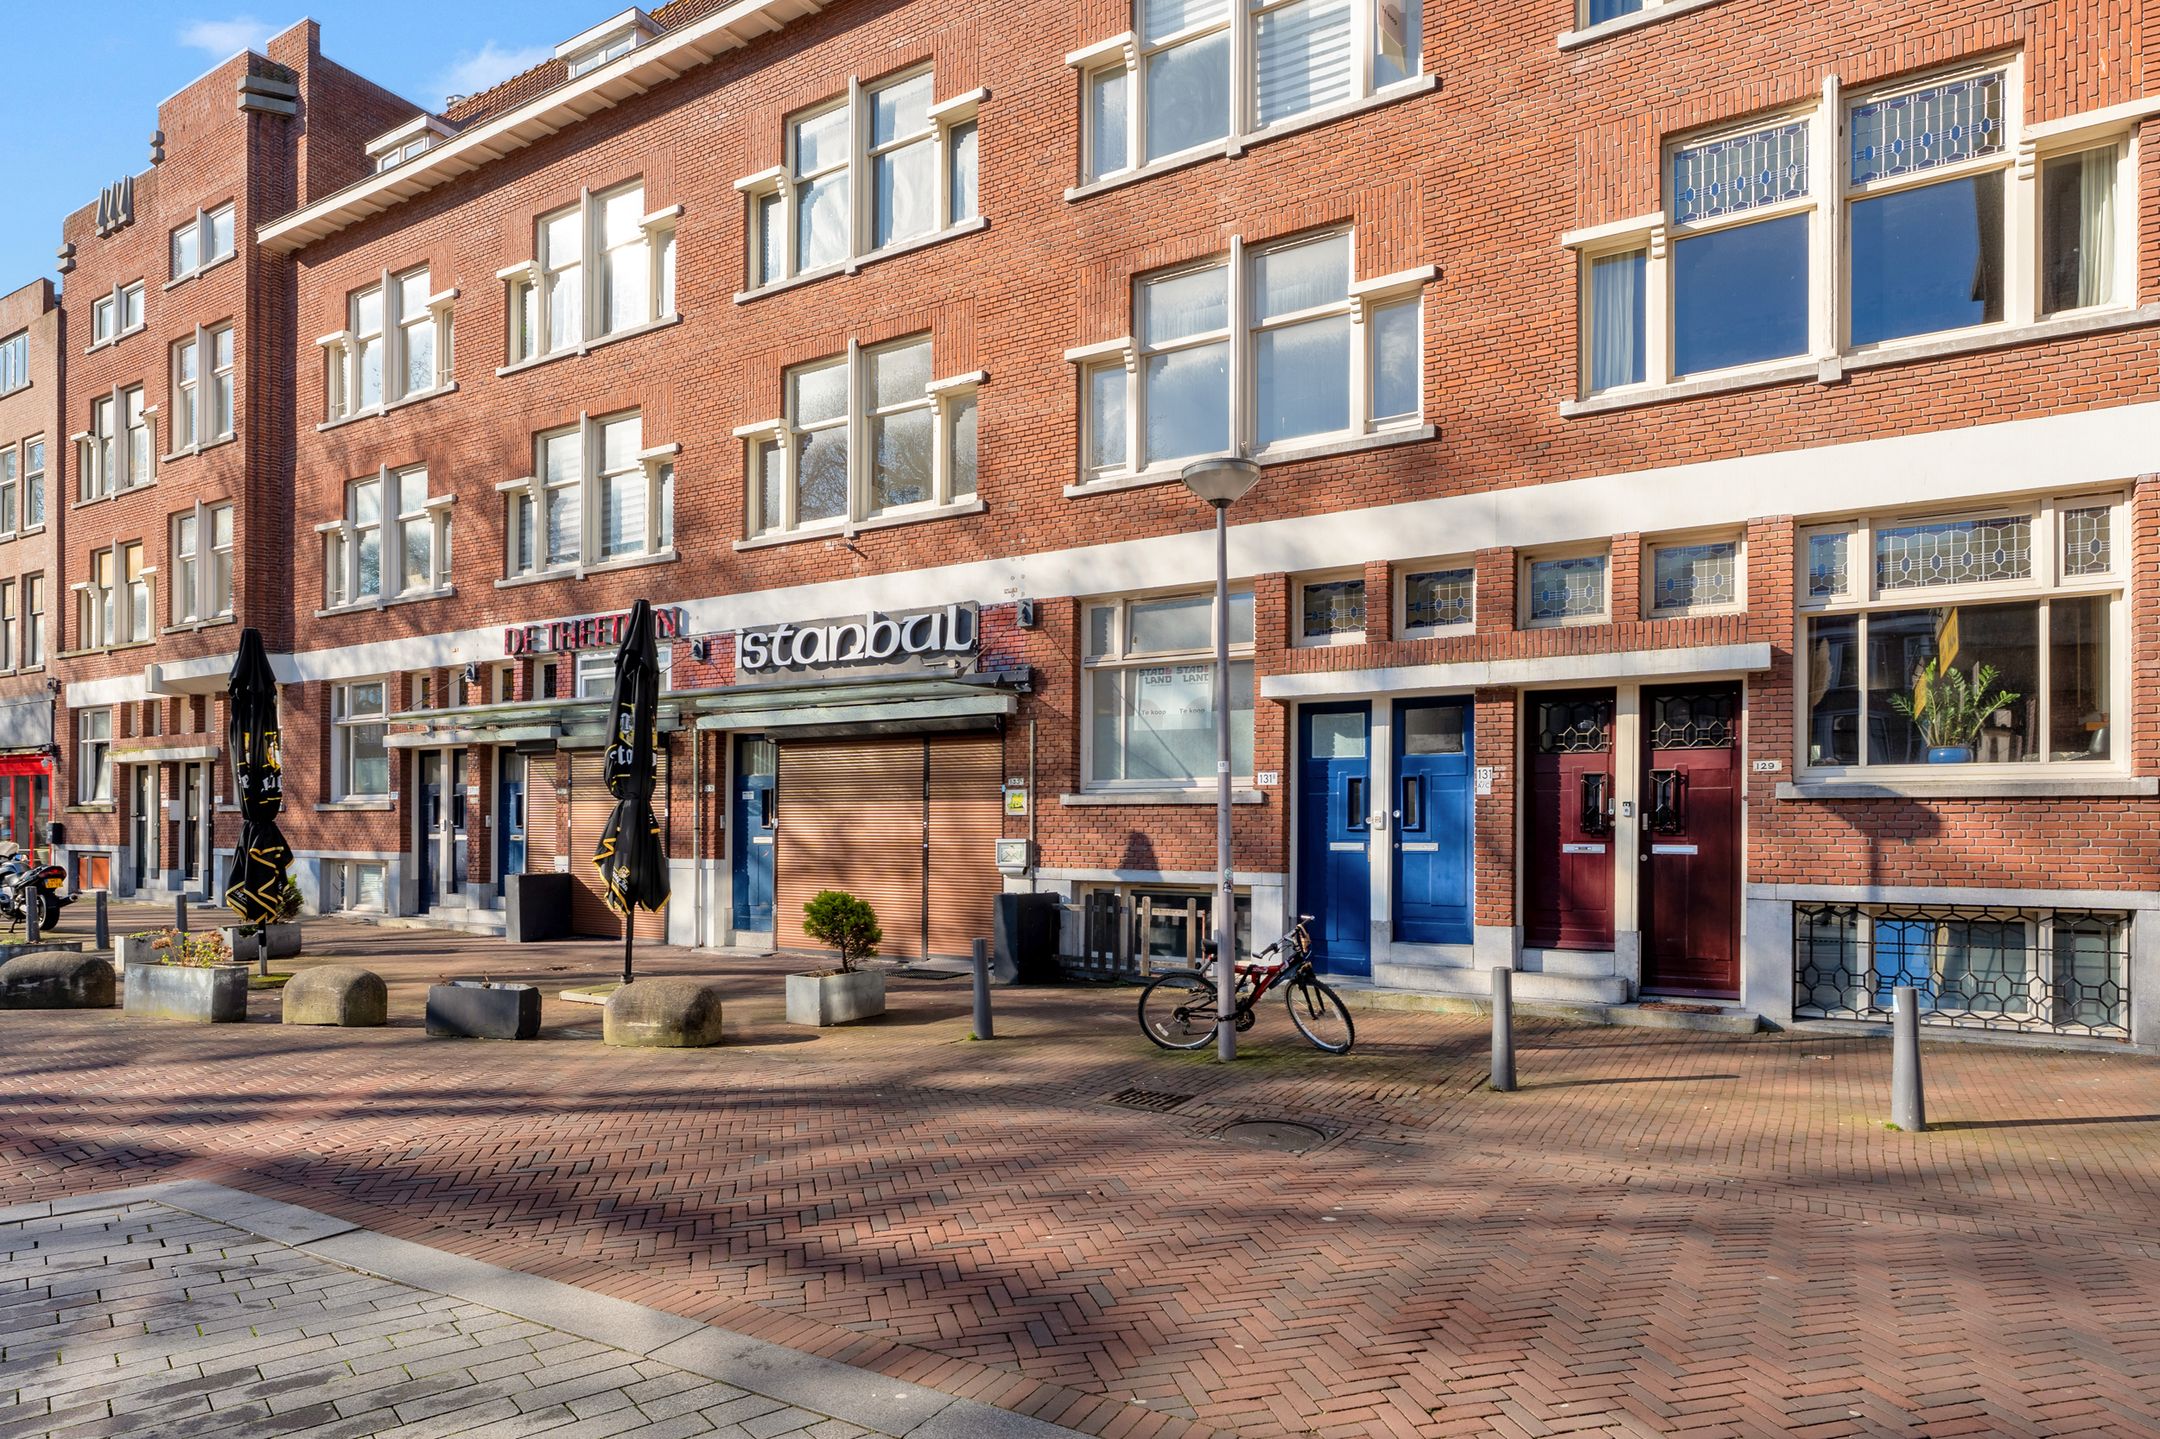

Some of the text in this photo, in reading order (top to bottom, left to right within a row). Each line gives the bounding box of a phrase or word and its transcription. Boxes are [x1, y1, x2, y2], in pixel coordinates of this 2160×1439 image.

[504, 607, 681, 656] DE THEETN
[1145, 676, 1172, 684] LAND
[1756, 762, 1775, 770] 129
[1478, 769, 1491, 779] 131
